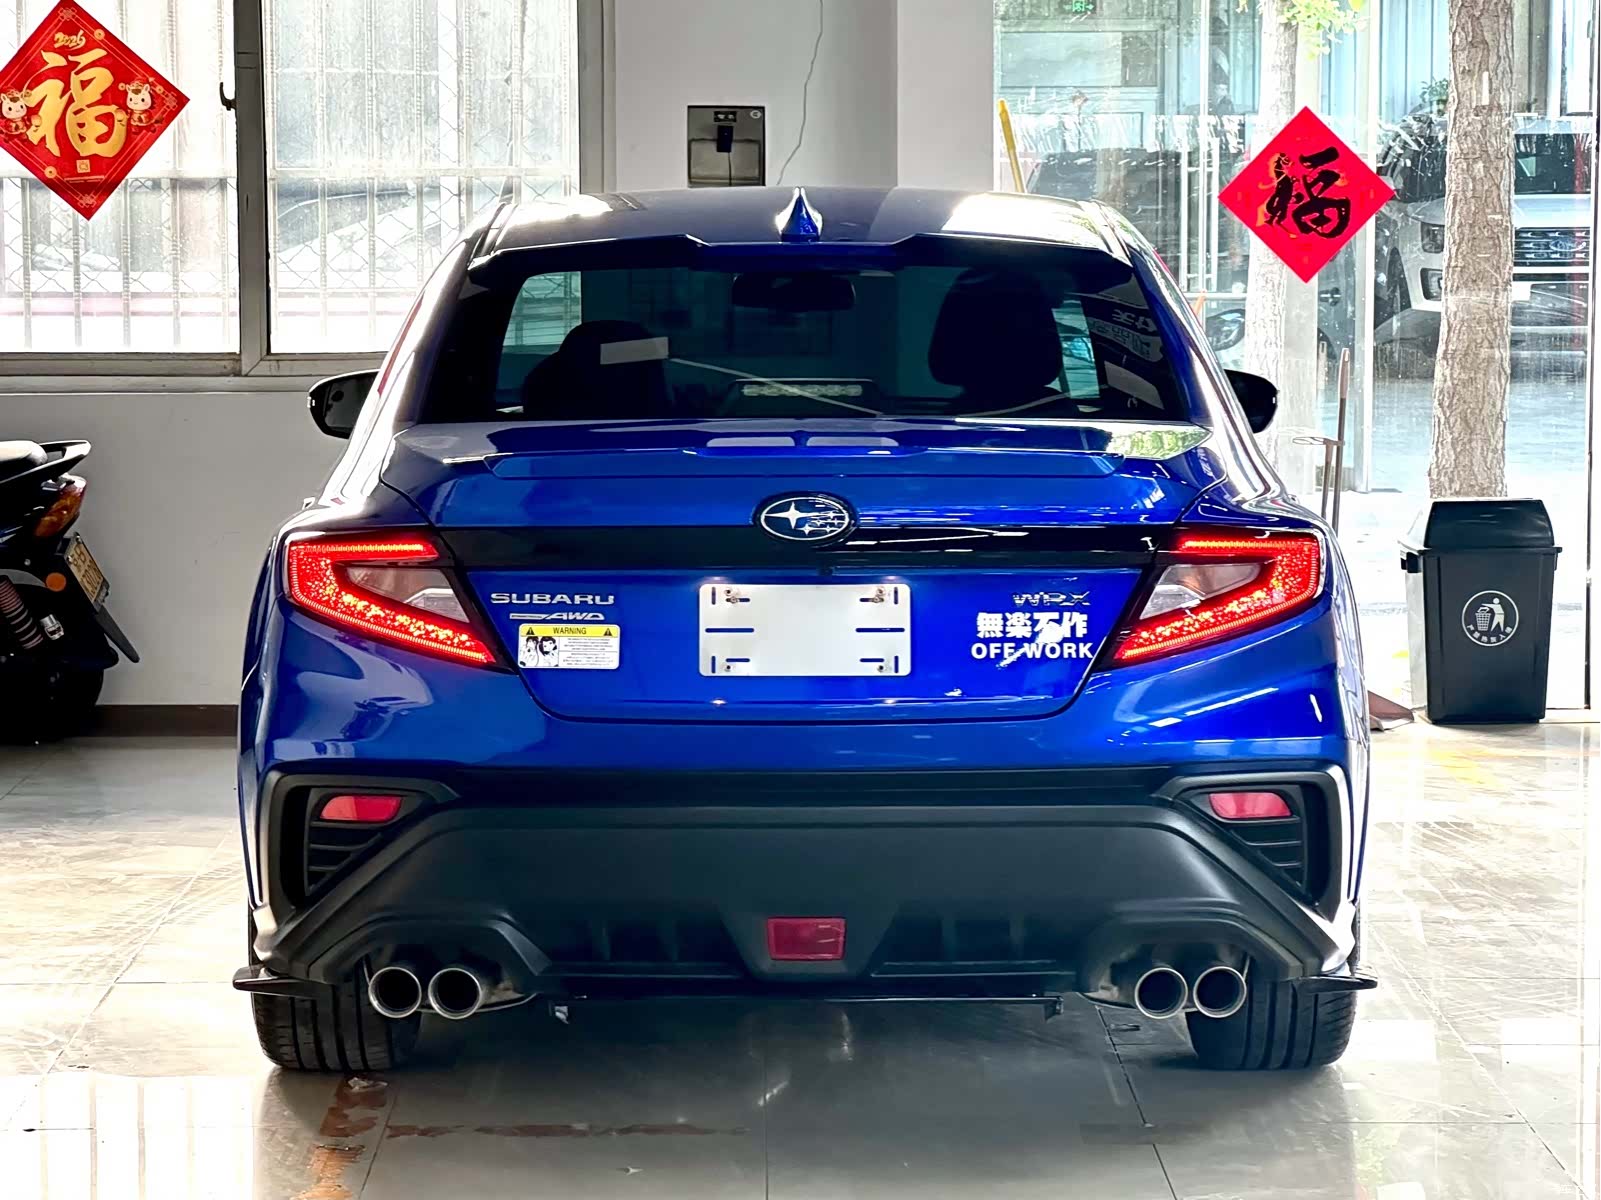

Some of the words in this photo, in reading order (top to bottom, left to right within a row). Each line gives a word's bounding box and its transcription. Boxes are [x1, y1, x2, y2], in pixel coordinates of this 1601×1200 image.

[54, 29, 86, 51] 2026
[24, 48, 127, 157] 福
[1258, 146, 1351, 239] 福
[490, 592, 615, 605] SUBARU
[543, 612, 605, 620] AWD
[552, 626, 587, 635] WARNING
[971, 642, 1016, 659] OFF
[1023, 642, 1093, 659] WORK
